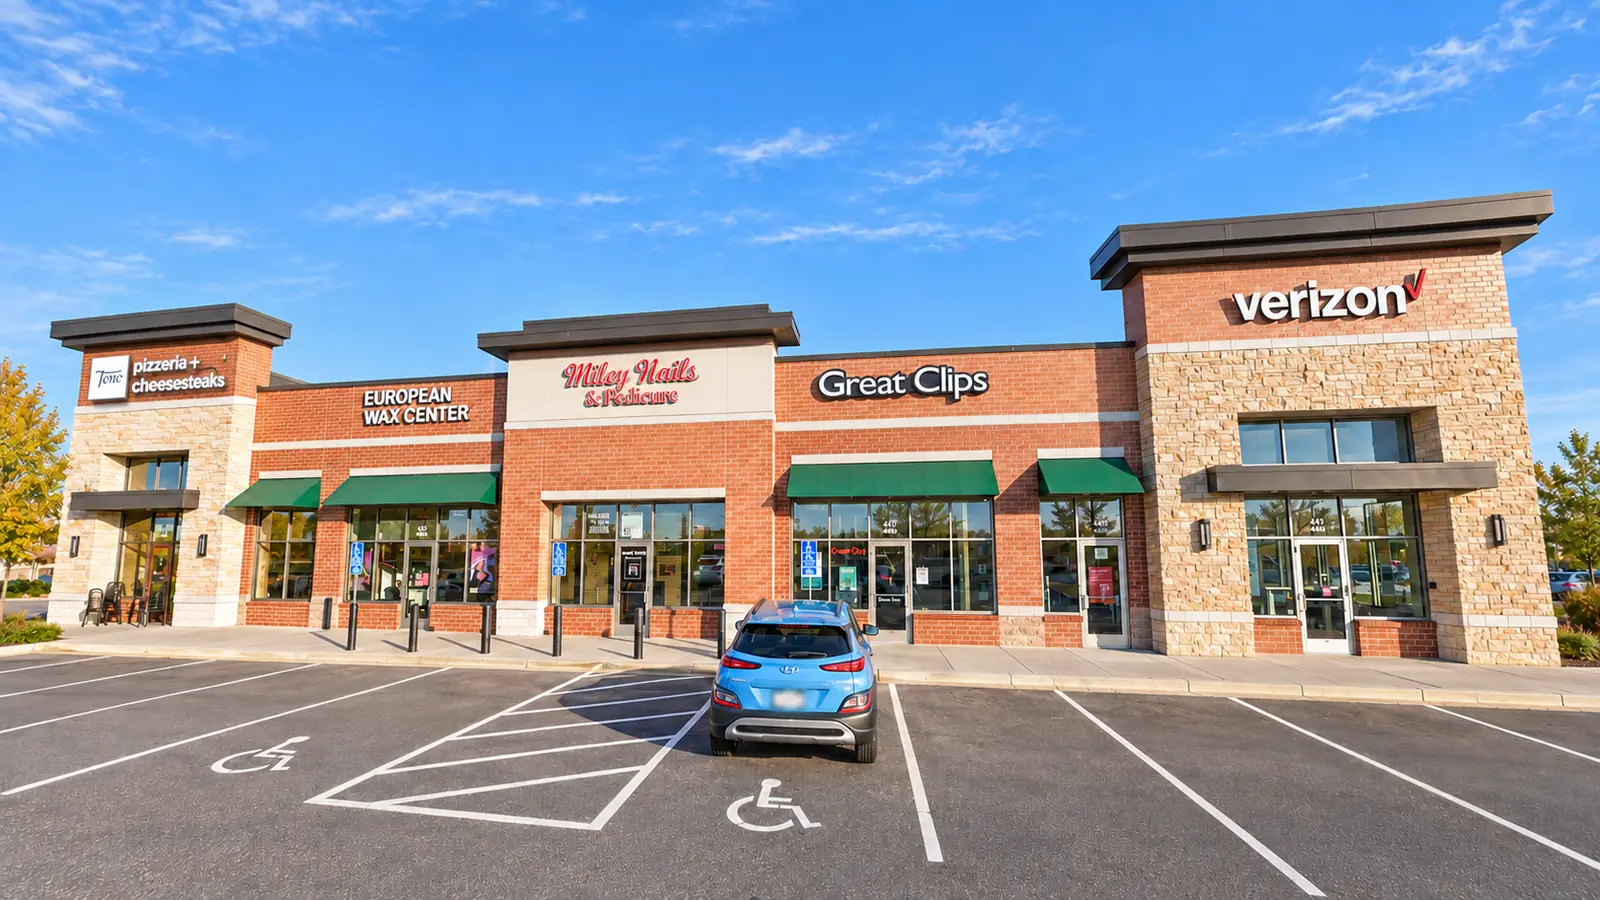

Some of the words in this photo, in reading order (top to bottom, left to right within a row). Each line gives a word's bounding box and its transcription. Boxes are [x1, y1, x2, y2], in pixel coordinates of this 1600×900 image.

[1233, 280, 1407, 321] verizon
[133, 354, 187, 376] pizzeria
[562, 361, 630, 392] Miley
[635, 357, 699, 384] Nails
[131, 372, 225, 393] cheesesteaks
[818, 370, 906, 397] Great
[914, 366, 988, 400] Clips
[363, 386, 452, 406] EUROPEAN
[584, 390, 602, 407] &
[603, 387, 679, 407] Pedicure
[363, 408, 400, 425] WAX
[403, 405, 469, 423] CENTER
